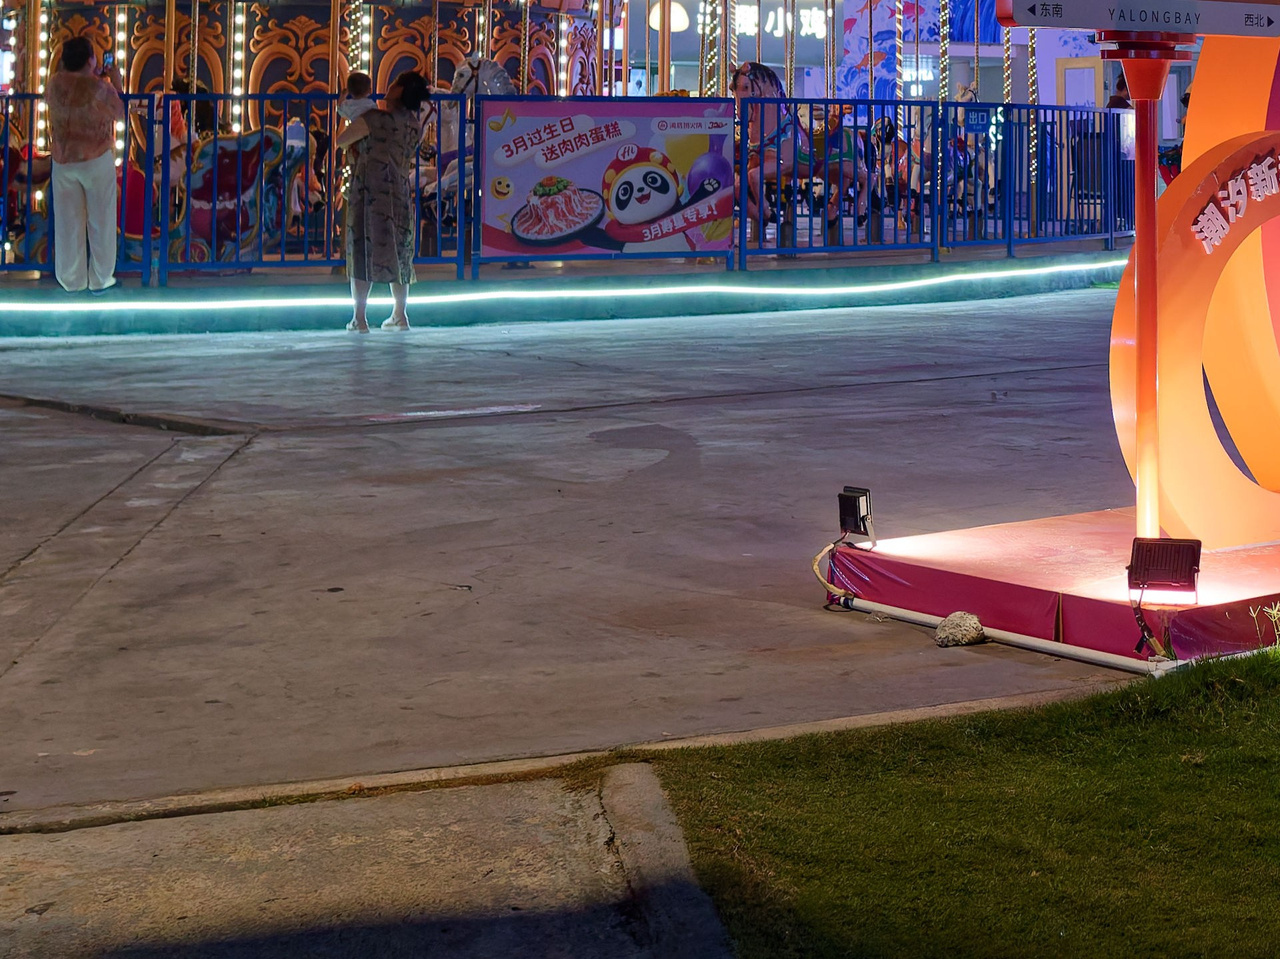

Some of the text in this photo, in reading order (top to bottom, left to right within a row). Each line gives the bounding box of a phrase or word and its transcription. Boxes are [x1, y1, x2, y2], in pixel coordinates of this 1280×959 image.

[1039, 1, 1063, 18] 东南
[1108, 8, 1201, 25] YALONGBAY
[1244, 13, 1265, 28] 西北
[968, 111, 987, 124] 出口
[501, 116, 576, 159] 3月过生日
[541, 120, 623, 163] 送肉肉蛋糕
